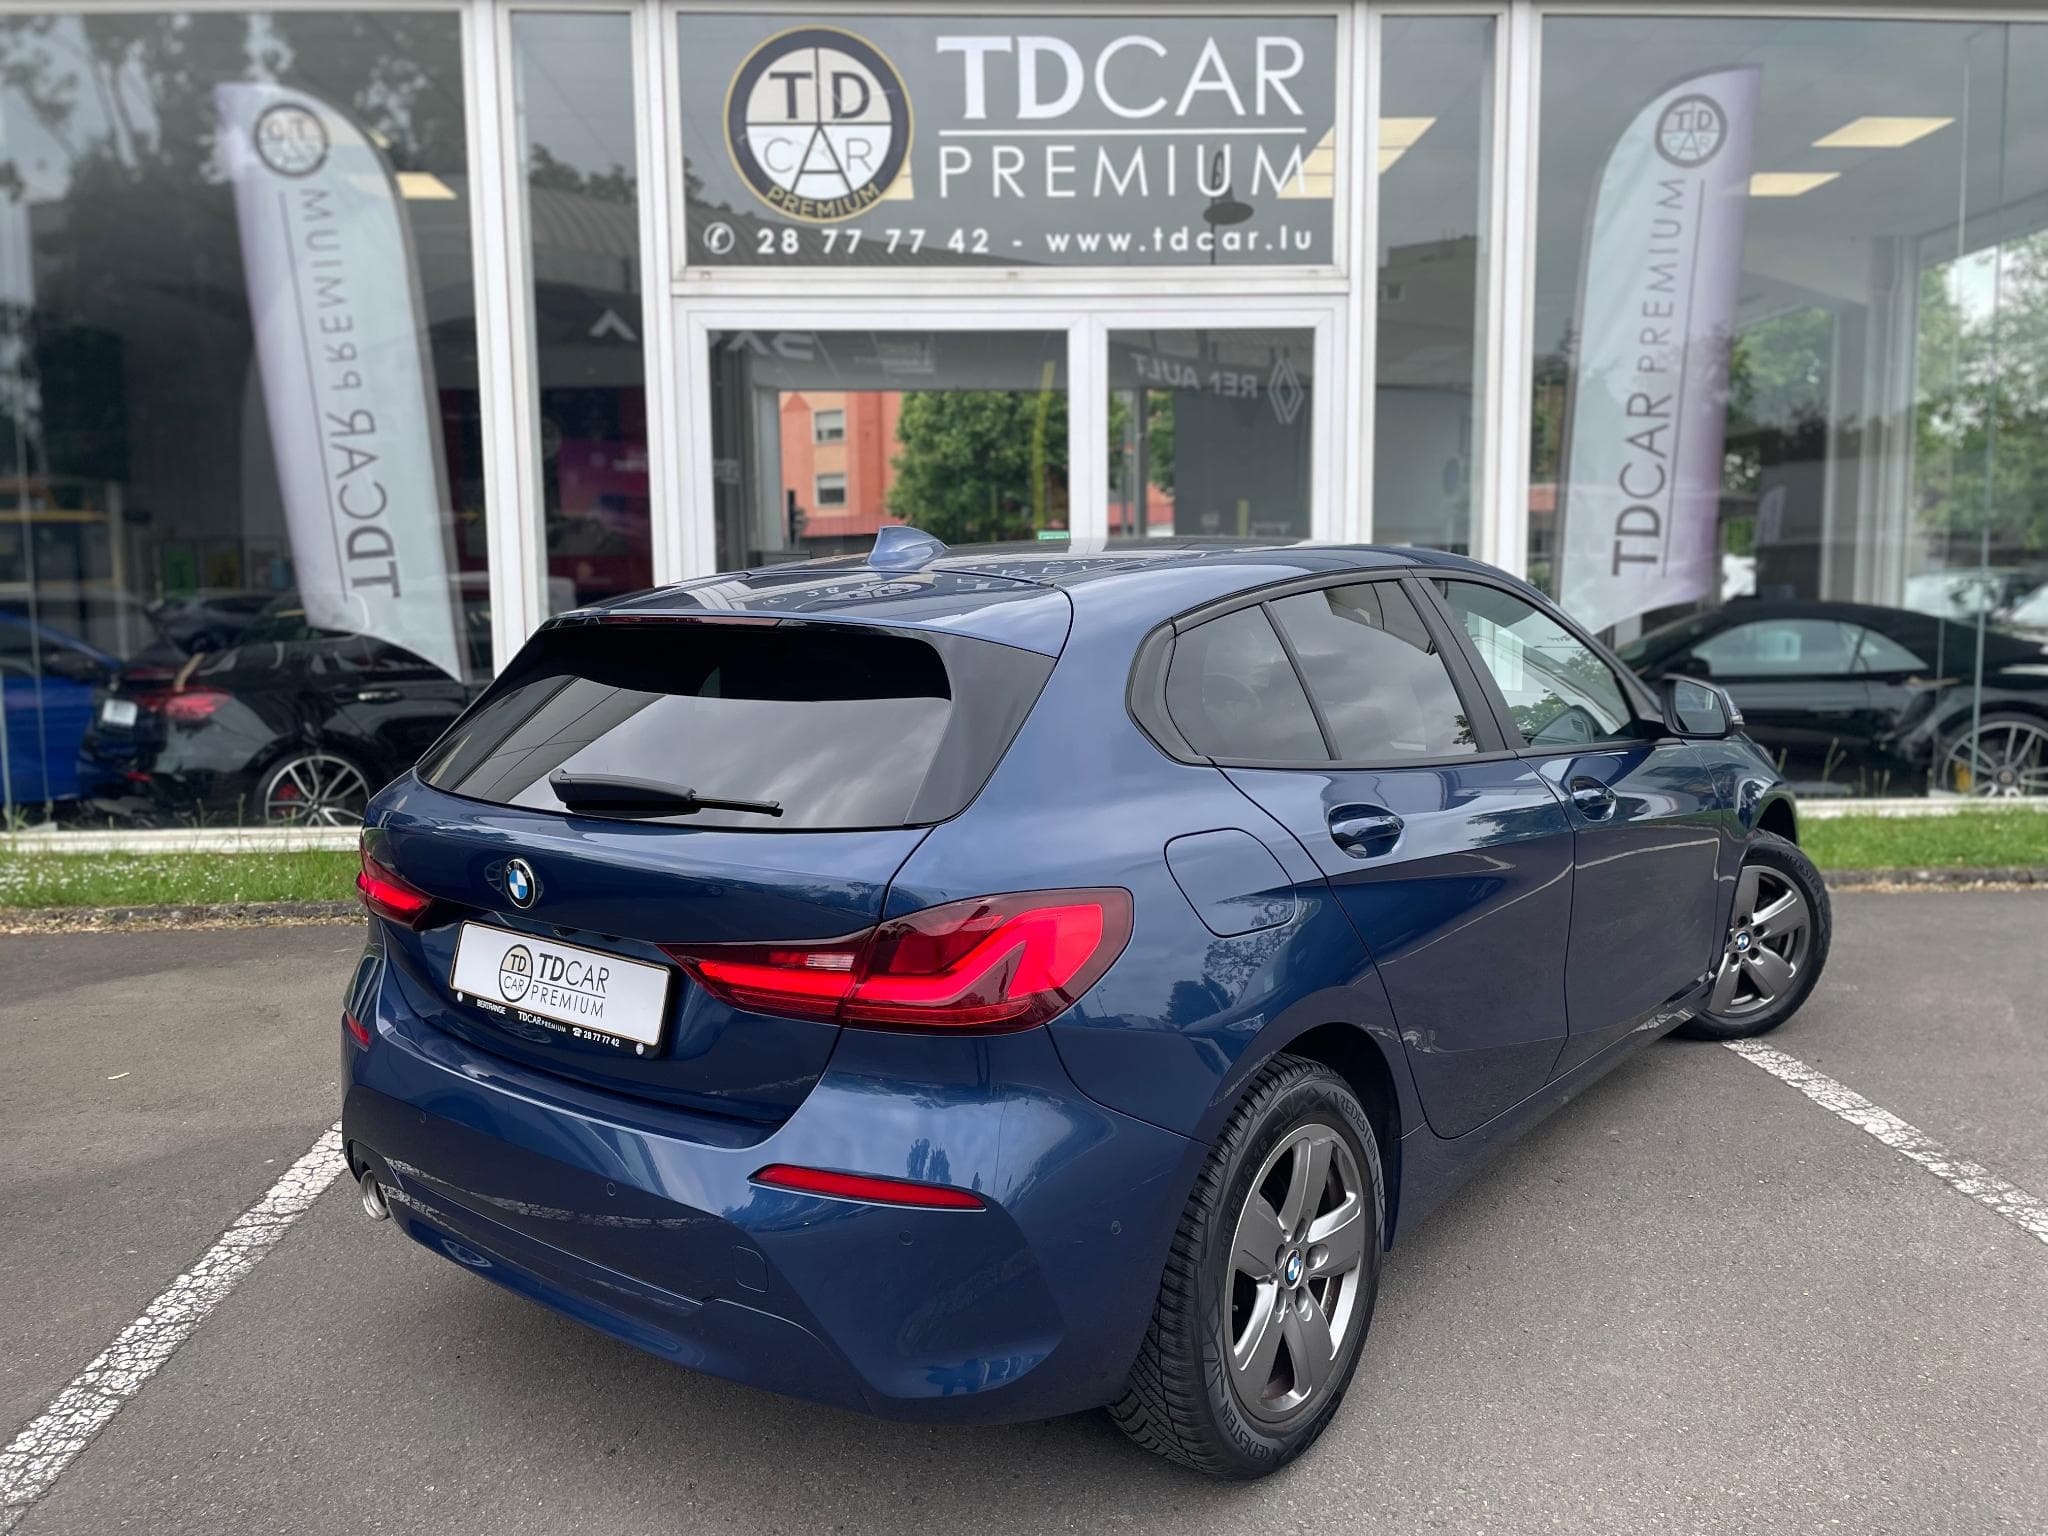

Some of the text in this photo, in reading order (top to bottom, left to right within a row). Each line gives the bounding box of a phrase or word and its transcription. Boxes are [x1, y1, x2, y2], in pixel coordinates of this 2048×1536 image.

[936, 36, 1305, 119] TDCAR
[764, 126, 873, 193] CAR
[940, 144, 1306, 199] PREMIUM
[766, 182, 880, 219] PREMIUM
[756, 229, 800, 254] 28
[823, 228, 862, 254] 77
[885, 229, 925, 254] 77
[947, 229, 989, 253] 42
[1046, 225, 1312, 252] www.tdcar.lu
[1611, 177, 1686, 576] TDCAR PREMIUM
[511, 954, 527, 972] TD
[538, 953, 610, 994] TDCAR
[503, 976, 525, 993] CAR
[530, 985, 604, 1018] PREMIUM
[476, 998, 507, 1015] BERTRANGE
[583, 1030, 592, 1040] 28
[592, 1033, 601, 1042] 77
[601, 1035, 611, 1044] 77
[610, 1037, 620, 1047] 42
